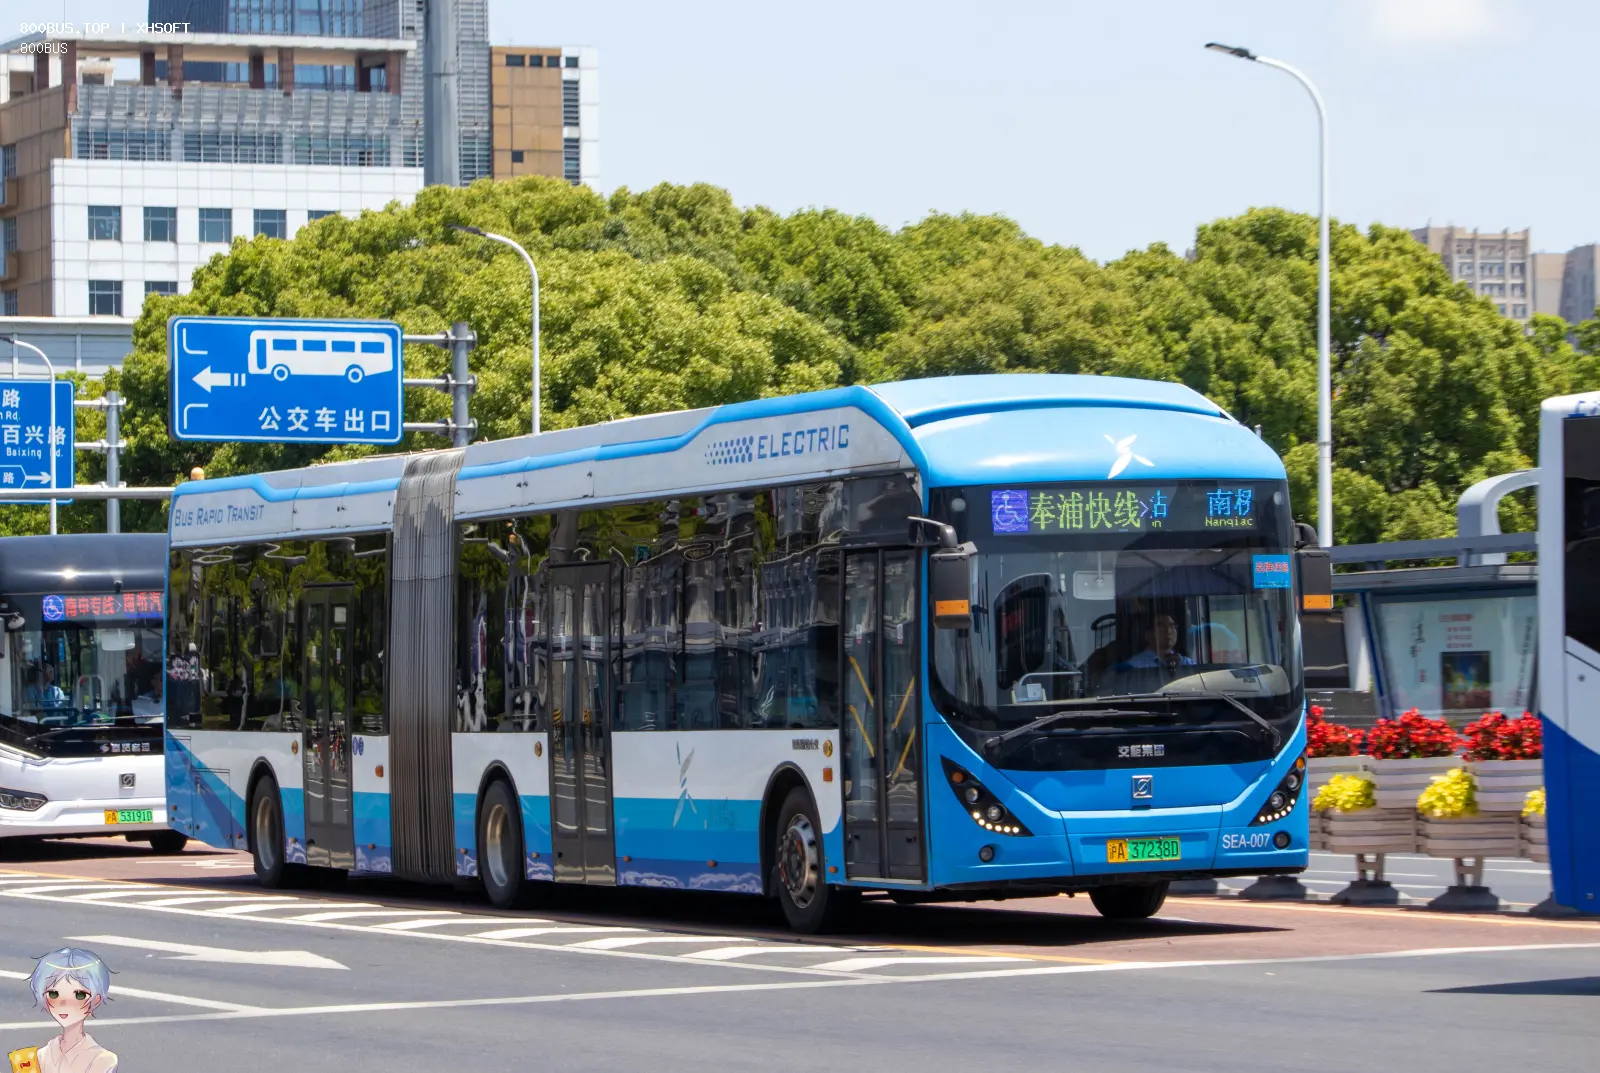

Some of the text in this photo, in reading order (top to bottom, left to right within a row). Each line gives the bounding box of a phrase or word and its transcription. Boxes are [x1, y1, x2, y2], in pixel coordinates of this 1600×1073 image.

[2, 388, 20, 408] 路
[258, 406, 391, 433] 公交车出口
[1, 424, 66, 445] 百兴路
[757, 424, 849, 459] ELECTRIC
[6, 447, 63, 459] Baixing d.
[1029, 490, 1141, 530] 奉浦快线
[123, 592, 165, 612] 南桥汽
[1222, 833, 1270, 849] SEA-007
